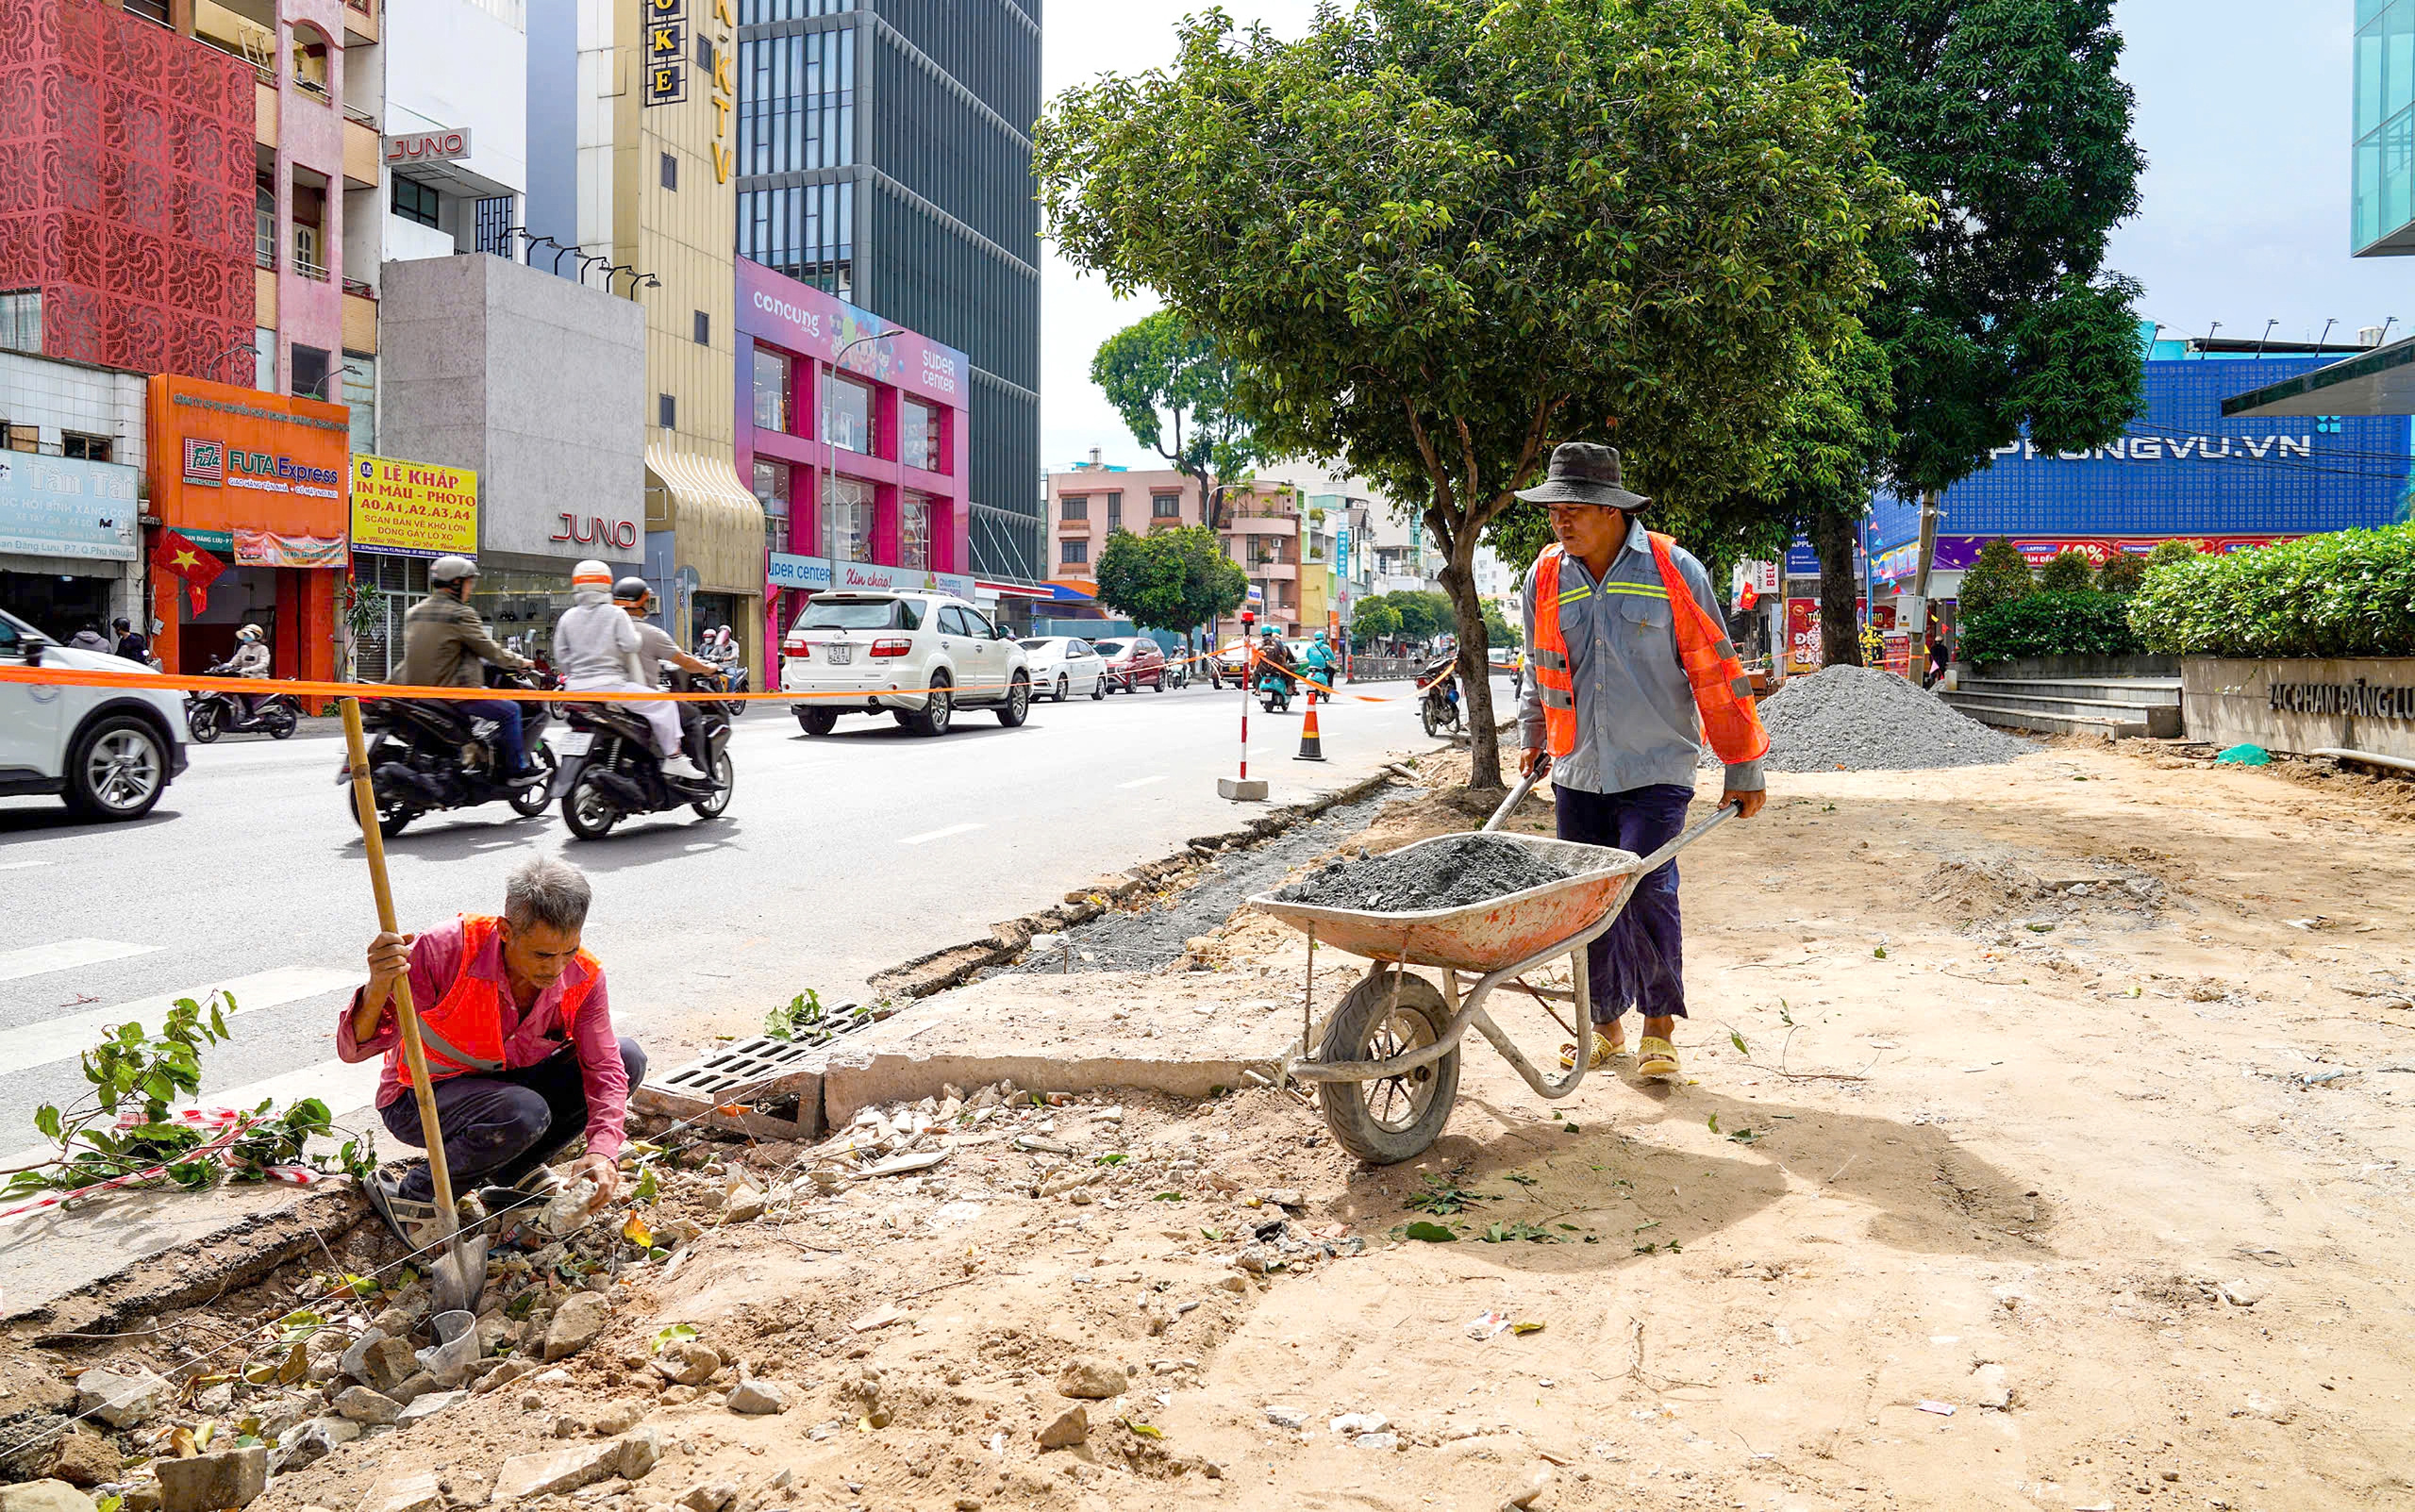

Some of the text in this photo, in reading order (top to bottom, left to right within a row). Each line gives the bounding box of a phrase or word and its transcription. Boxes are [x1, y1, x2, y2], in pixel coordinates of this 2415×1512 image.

[388, 134, 462, 158] JUNO
[754, 291, 820, 338] concung
[228, 449, 276, 475] FUTA
[277, 457, 338, 485] Express
[384, 464, 459, 490] LÊ KHẮP
[228, 477, 244, 486] GIAO
[357, 480, 374, 494] IN
[379, 484, 413, 499] MÀU
[427, 490, 476, 507] PHOTO
[364, 514, 391, 524] SCAN
[550, 512, 637, 549] JUNO
[845, 568, 865, 587] Xin
[2268, 684, 2291, 710] 24C
[2294, 684, 2336, 714] PHAN
